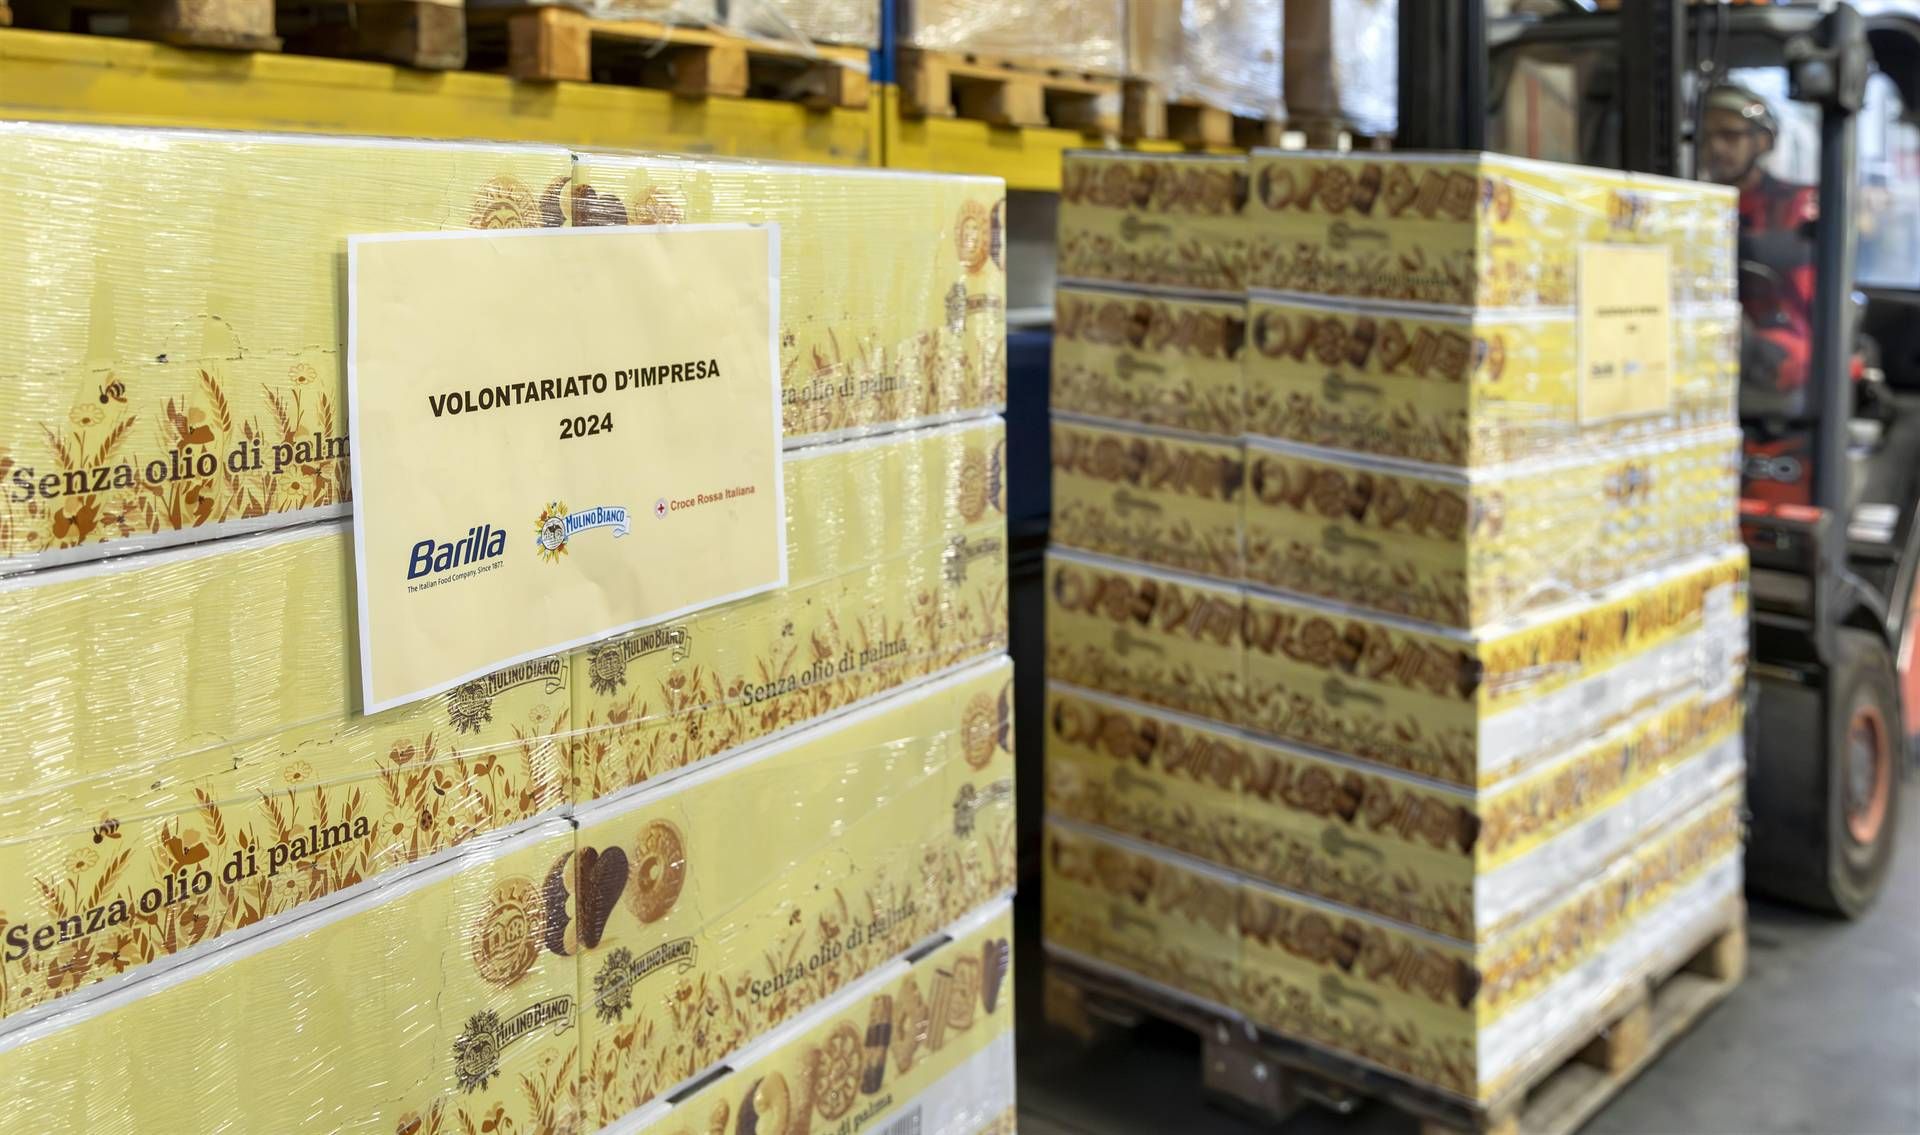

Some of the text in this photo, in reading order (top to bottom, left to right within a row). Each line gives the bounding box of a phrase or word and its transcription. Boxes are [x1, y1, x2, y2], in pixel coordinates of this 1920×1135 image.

[429, 359, 721, 418] VOLONTARIATO D'IMPRESA
[559, 412, 614, 440] 2024
[10, 432, 351, 504] Senza olio di palm
[670, 486, 755, 511] Croce Rossa Italiana
[565, 506, 625, 534] MULINO BIANCO
[407, 523, 507, 580] Barilla
[407, 586, 418, 594] The
[419, 580, 437, 589] Italian
[438, 575, 452, 585] Food
[477, 564, 491, 575] Since
[624, 634, 654, 661] MULINO
[742, 638, 907, 707] Senza olio di palma
[5, 815, 372, 963] Senza olio di palma
[629, 950, 661, 983] MULINO
[750, 963, 804, 1004] Senza
[809, 941, 842, 970] olio
[846, 928, 863, 950] di
[496, 1012, 533, 1049] MULINO
